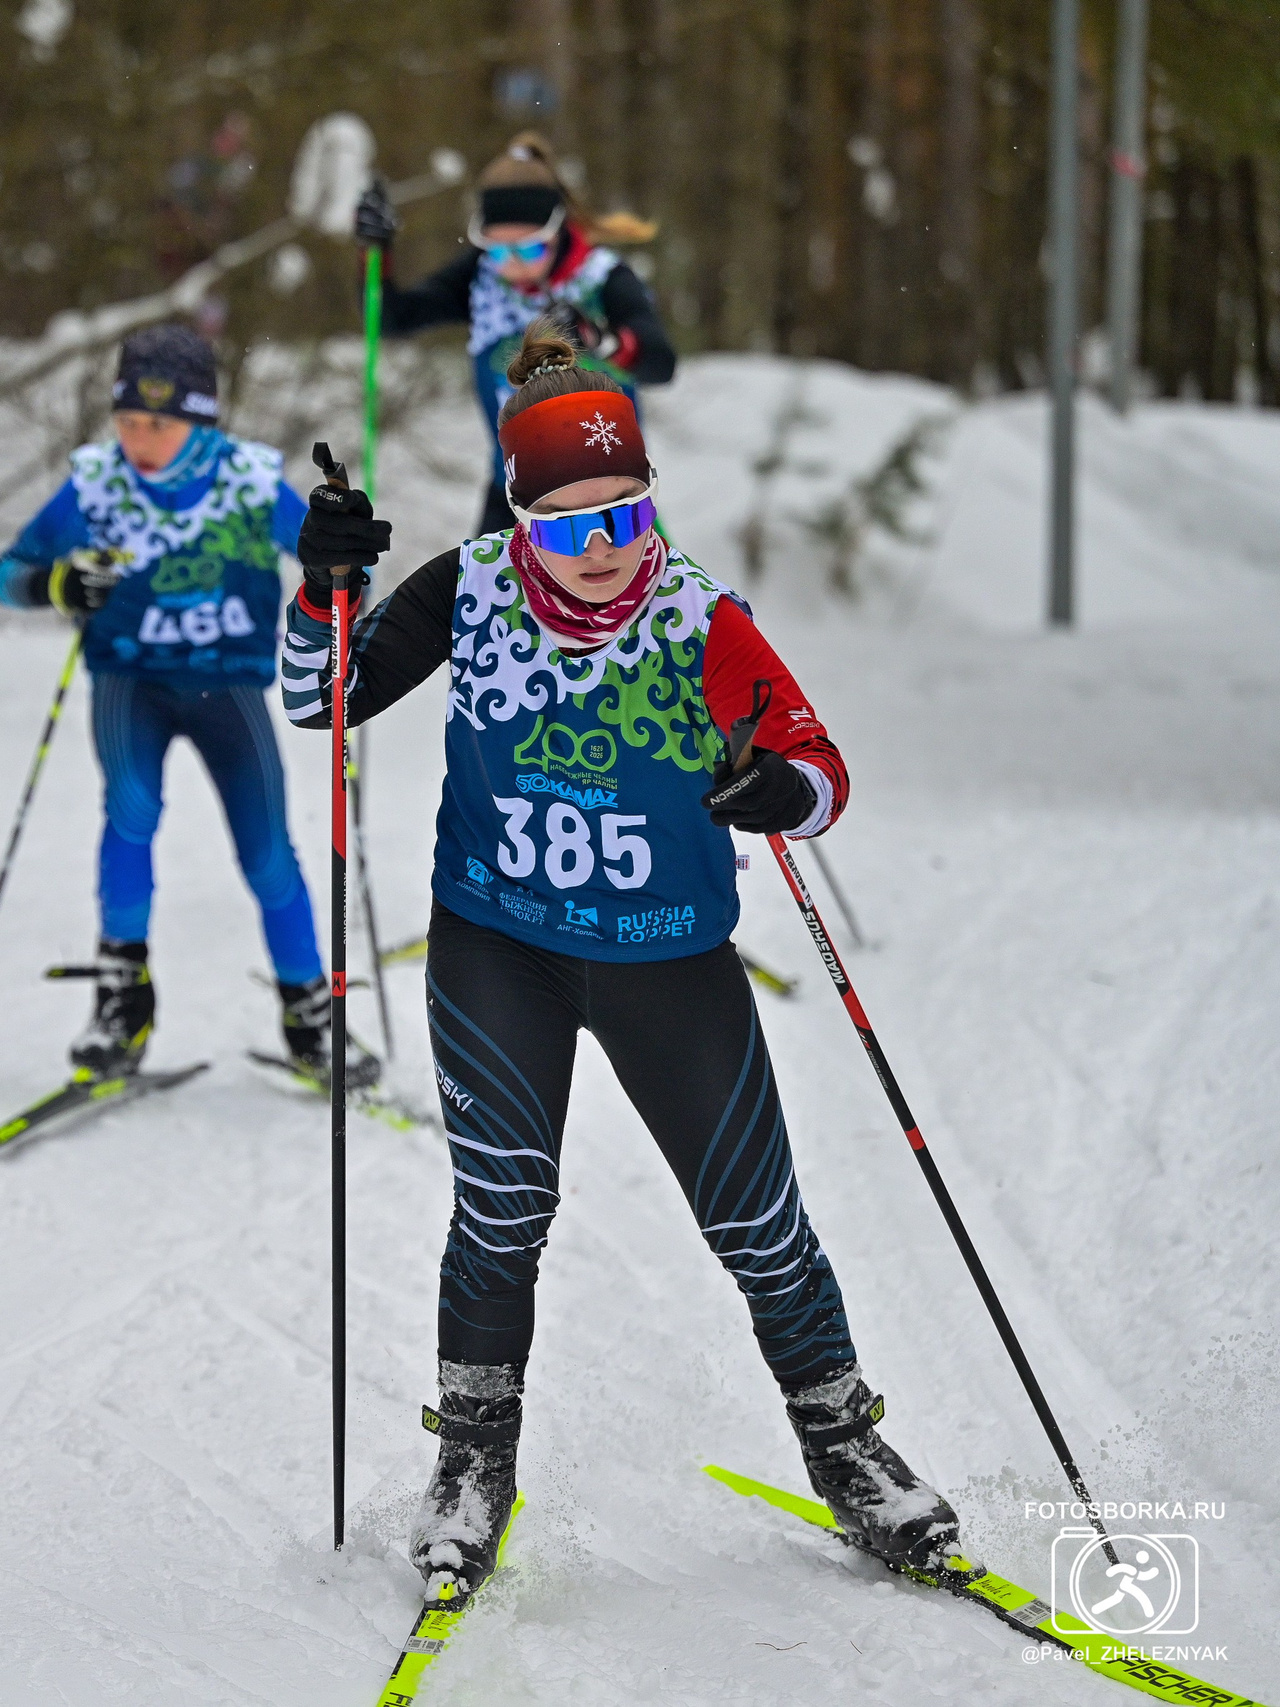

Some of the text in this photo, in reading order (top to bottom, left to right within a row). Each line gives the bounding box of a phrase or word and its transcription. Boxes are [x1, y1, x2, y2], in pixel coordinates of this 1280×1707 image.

[514, 714, 617, 774] 400
[549, 778, 619, 808] KAMAZ
[710, 769, 760, 806] NORDSKI
[493, 796, 651, 889] 385
[499, 892, 548, 912] ФЕДЕРАЦИЯ
[617, 905, 696, 933] RUSSIA
[617, 919, 696, 944] LOPPET
[802, 911, 846, 984] MADSHUS
[1107, 1655, 1234, 1707] FISCHER
